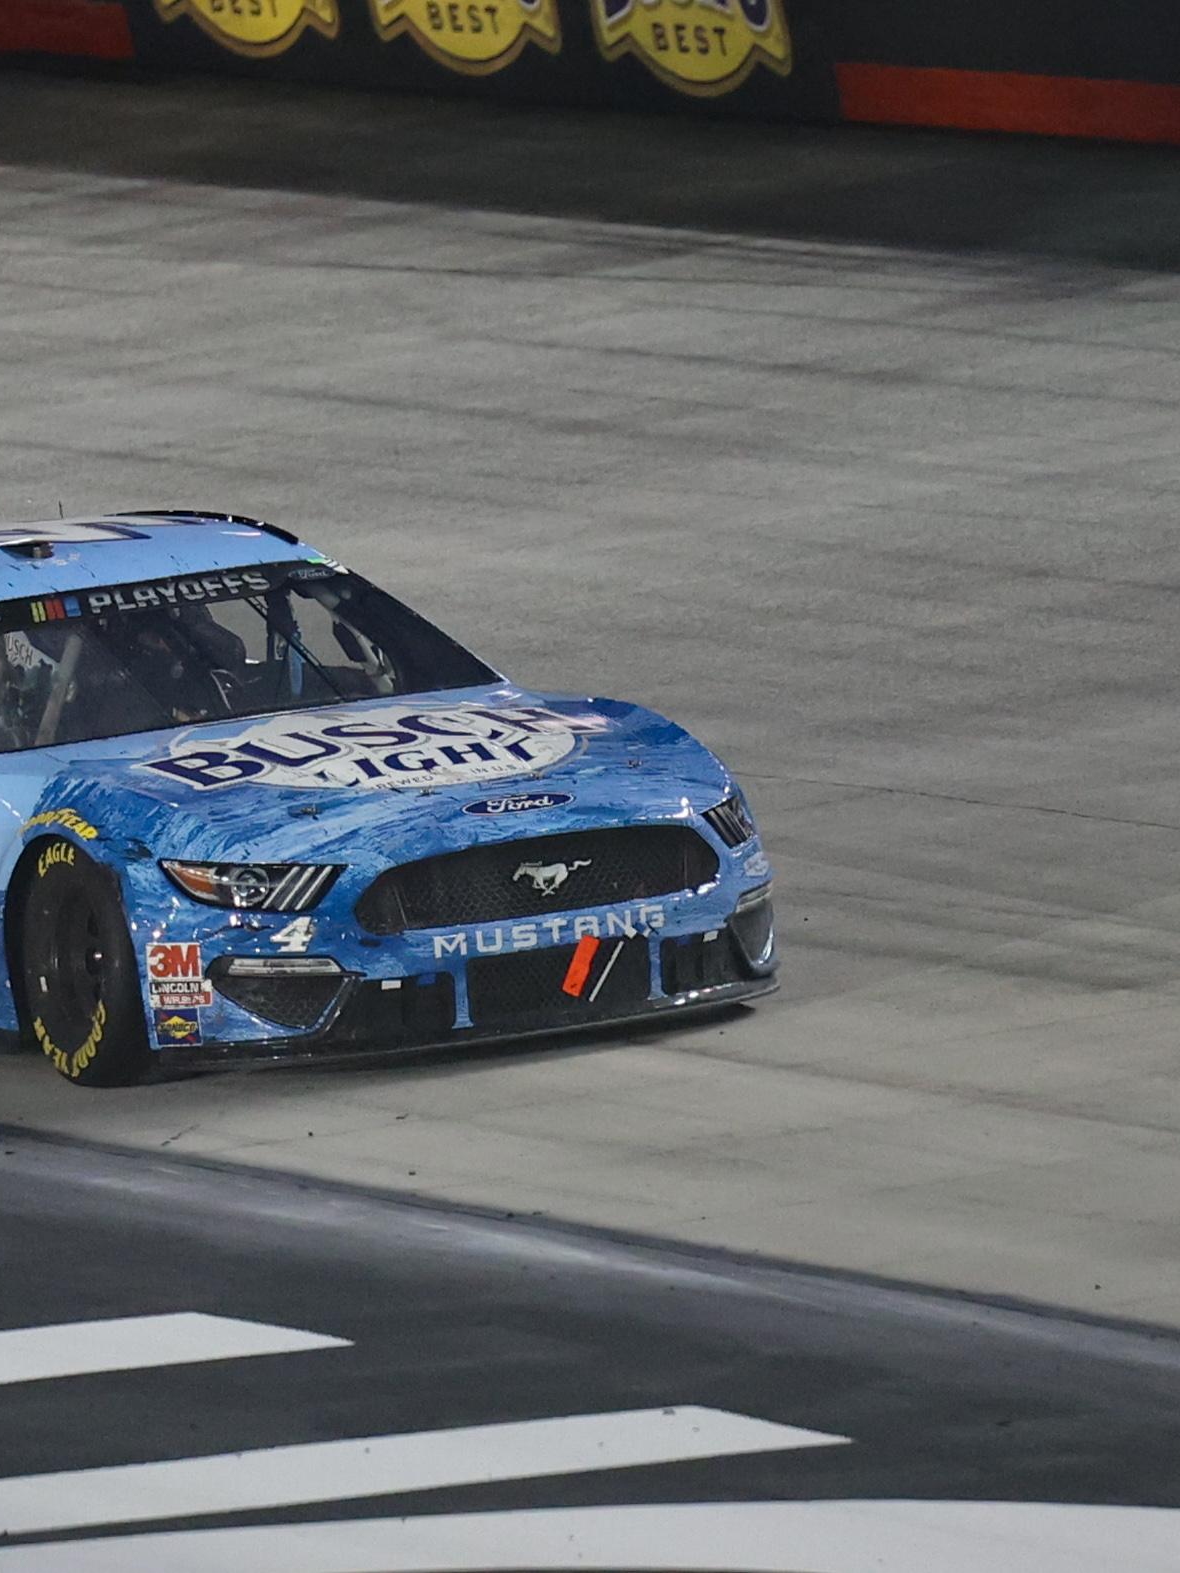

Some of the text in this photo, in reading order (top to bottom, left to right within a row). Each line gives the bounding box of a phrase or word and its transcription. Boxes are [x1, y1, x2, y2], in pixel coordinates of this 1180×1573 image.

[427, 1, 499, 34] BEST
[652, 22, 727, 56] BEST
[88, 571, 270, 613] PLAYOFFS
[6, 635, 34, 667] USCH
[144, 708, 606, 788] BUSCH
[485, 796, 554, 812] Ford
[38, 843, 75, 877] EAGLE
[270, 916, 312, 952] 4
[433, 905, 664, 958] MUSTANG
[150, 945, 200, 977] 3M
[151, 982, 199, 993] LINCOLN
